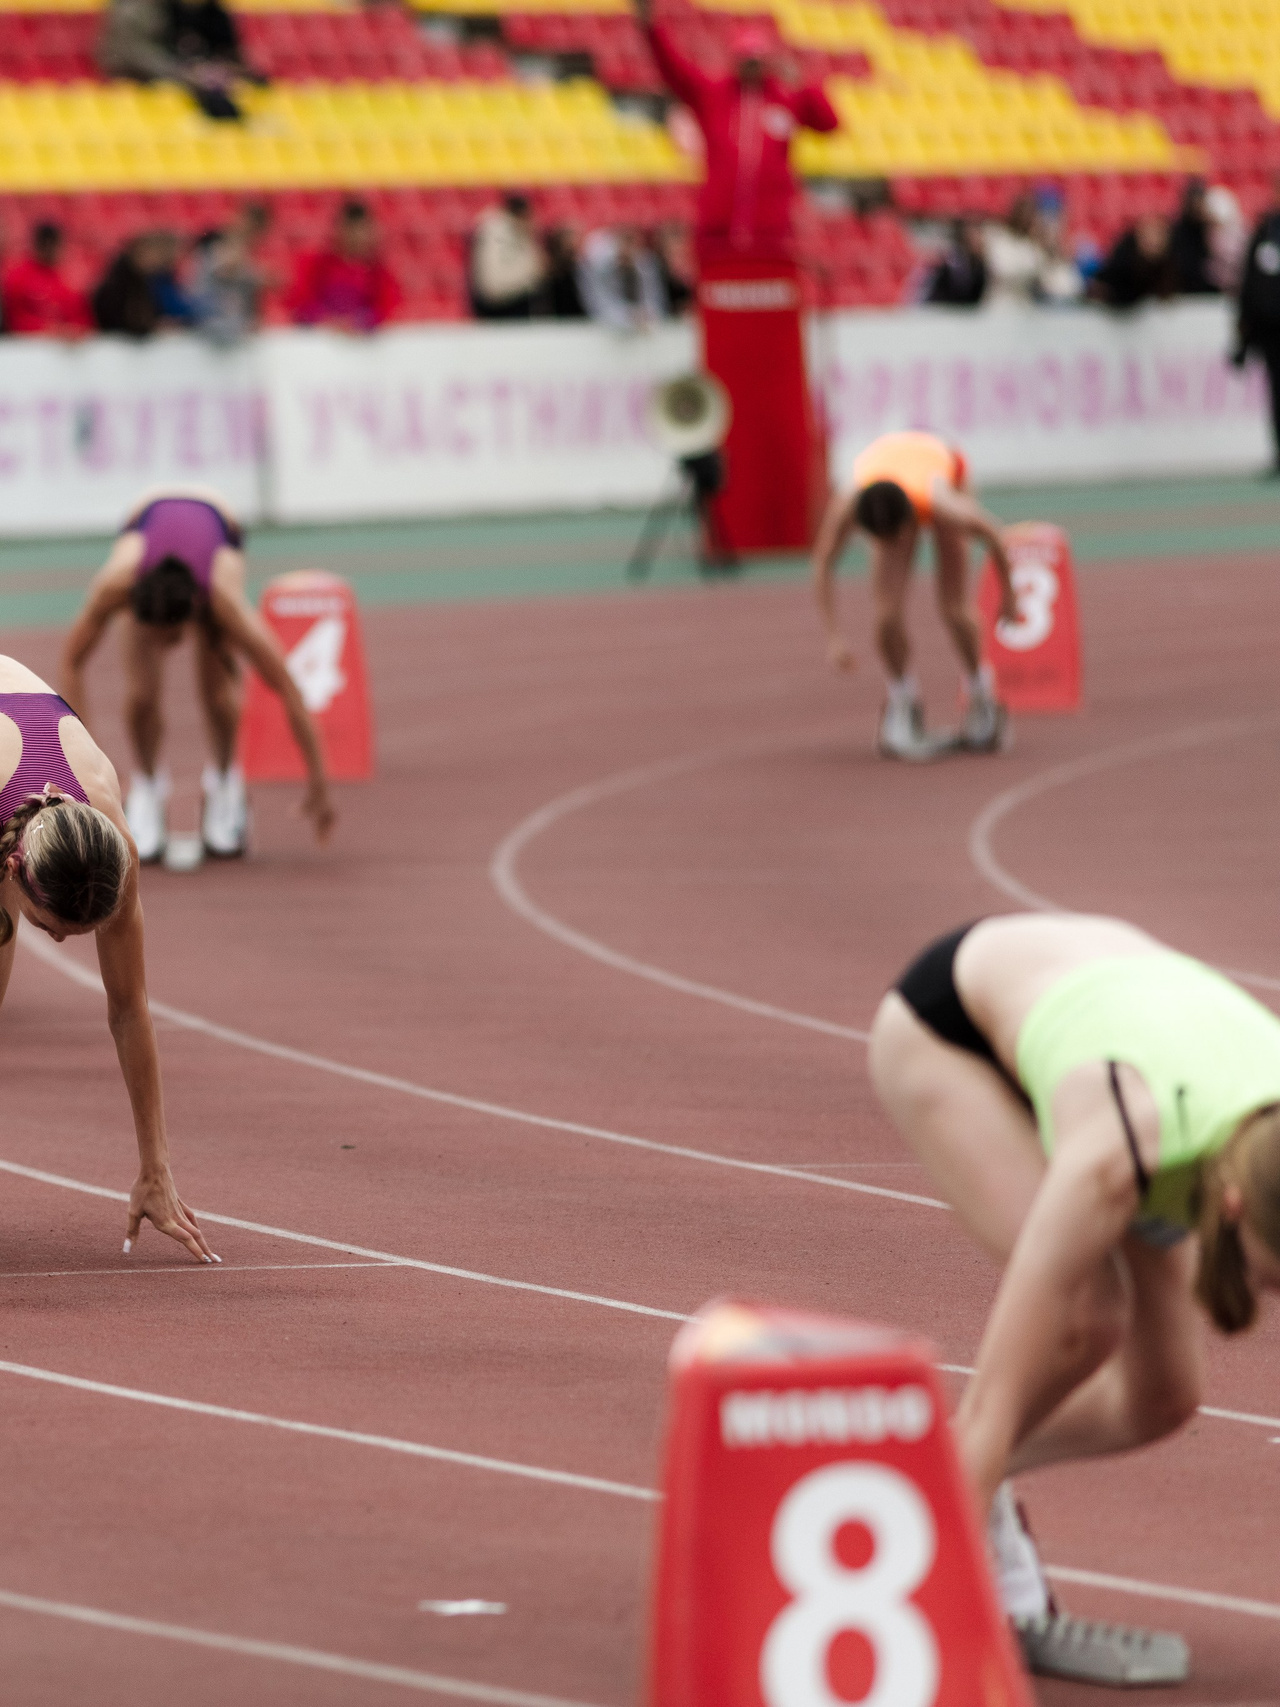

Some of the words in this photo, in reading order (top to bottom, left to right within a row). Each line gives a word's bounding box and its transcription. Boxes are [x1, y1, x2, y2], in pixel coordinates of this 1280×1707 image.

[995, 558, 1058, 651] 3
[286, 619, 346, 713] 4
[759, 1461, 940, 1707] 8
